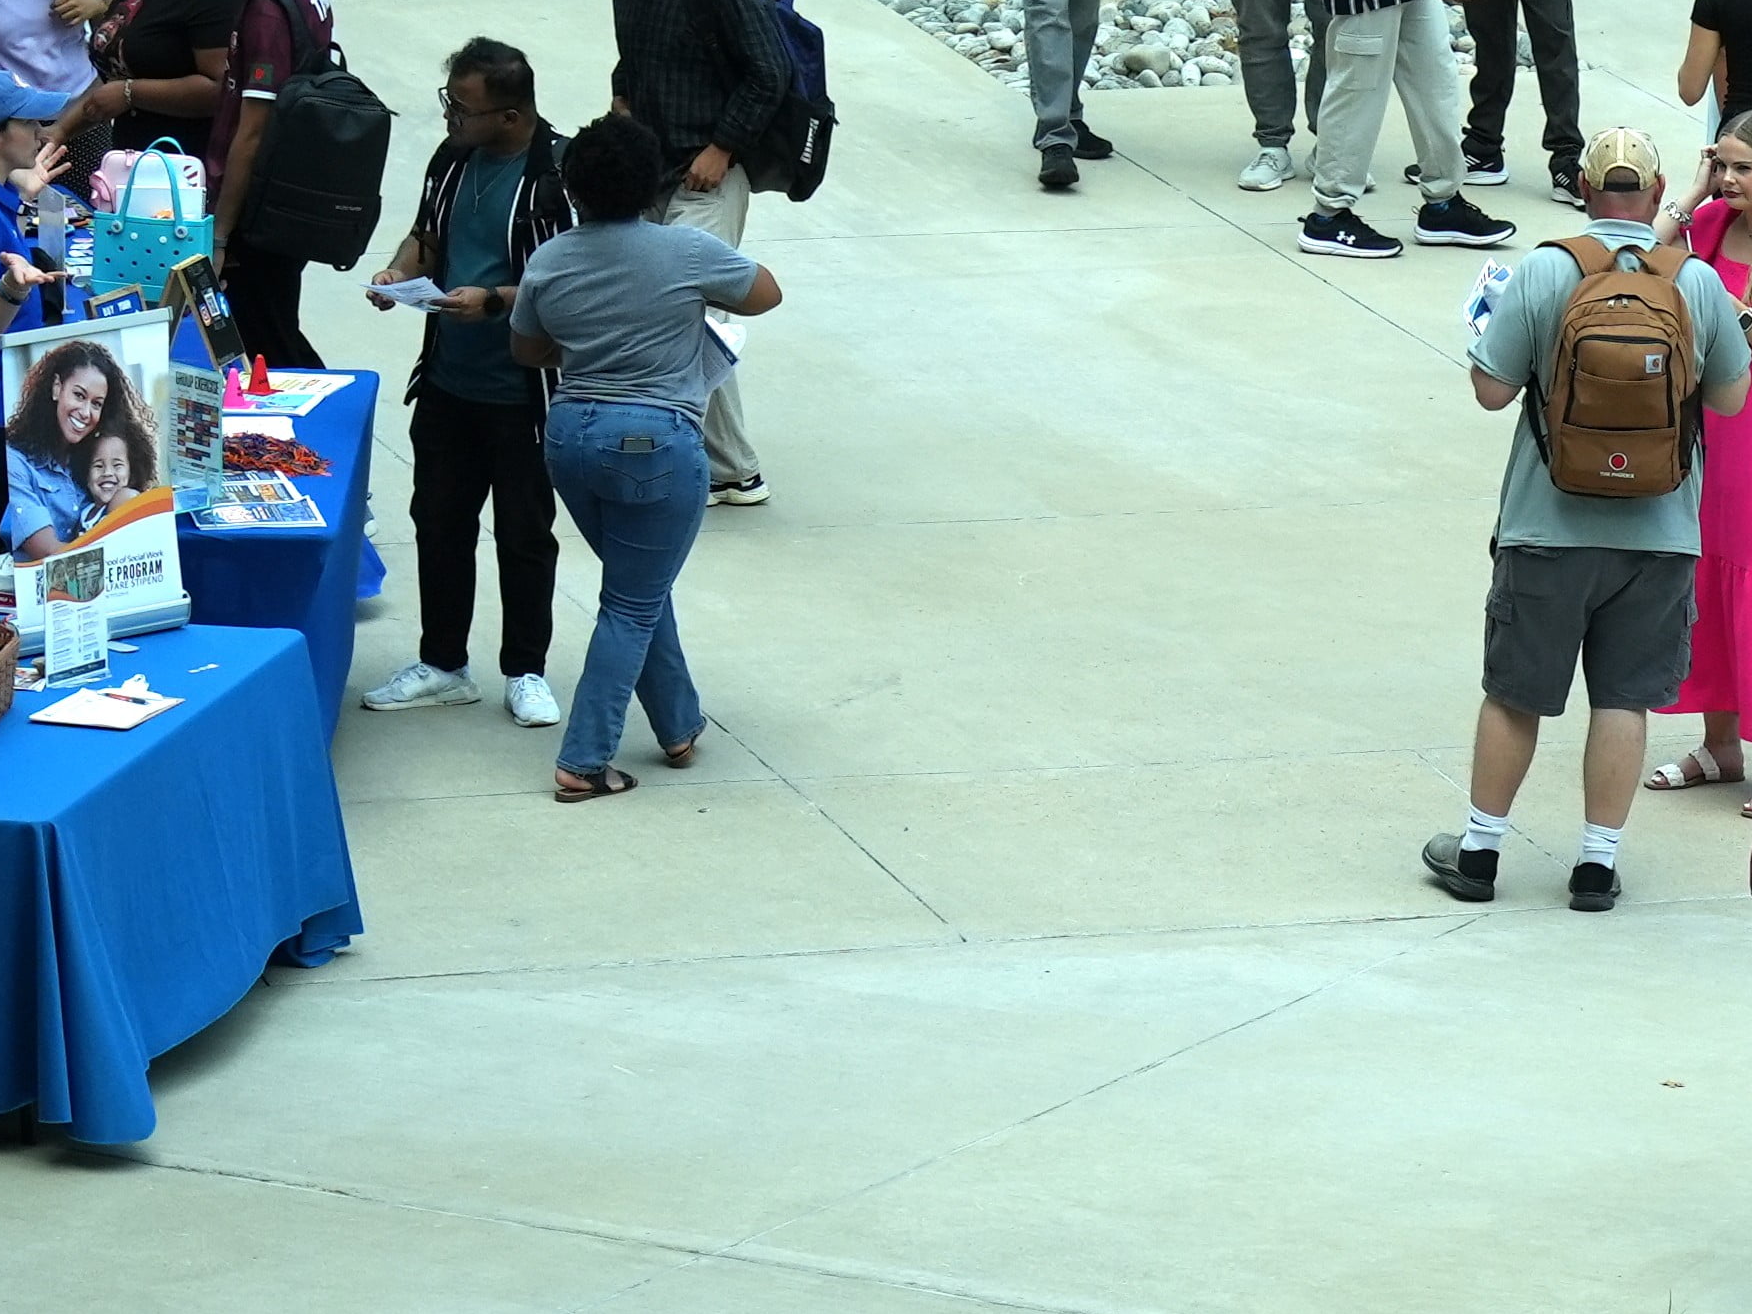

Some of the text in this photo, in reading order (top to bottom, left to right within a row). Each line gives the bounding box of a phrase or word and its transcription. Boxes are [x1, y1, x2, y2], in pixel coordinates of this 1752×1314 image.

[127, 553, 145, 563] Social
[147, 550, 164, 559] Work
[116, 559, 163, 581] PROGRAM
[106, 581, 129, 592] LFARE
